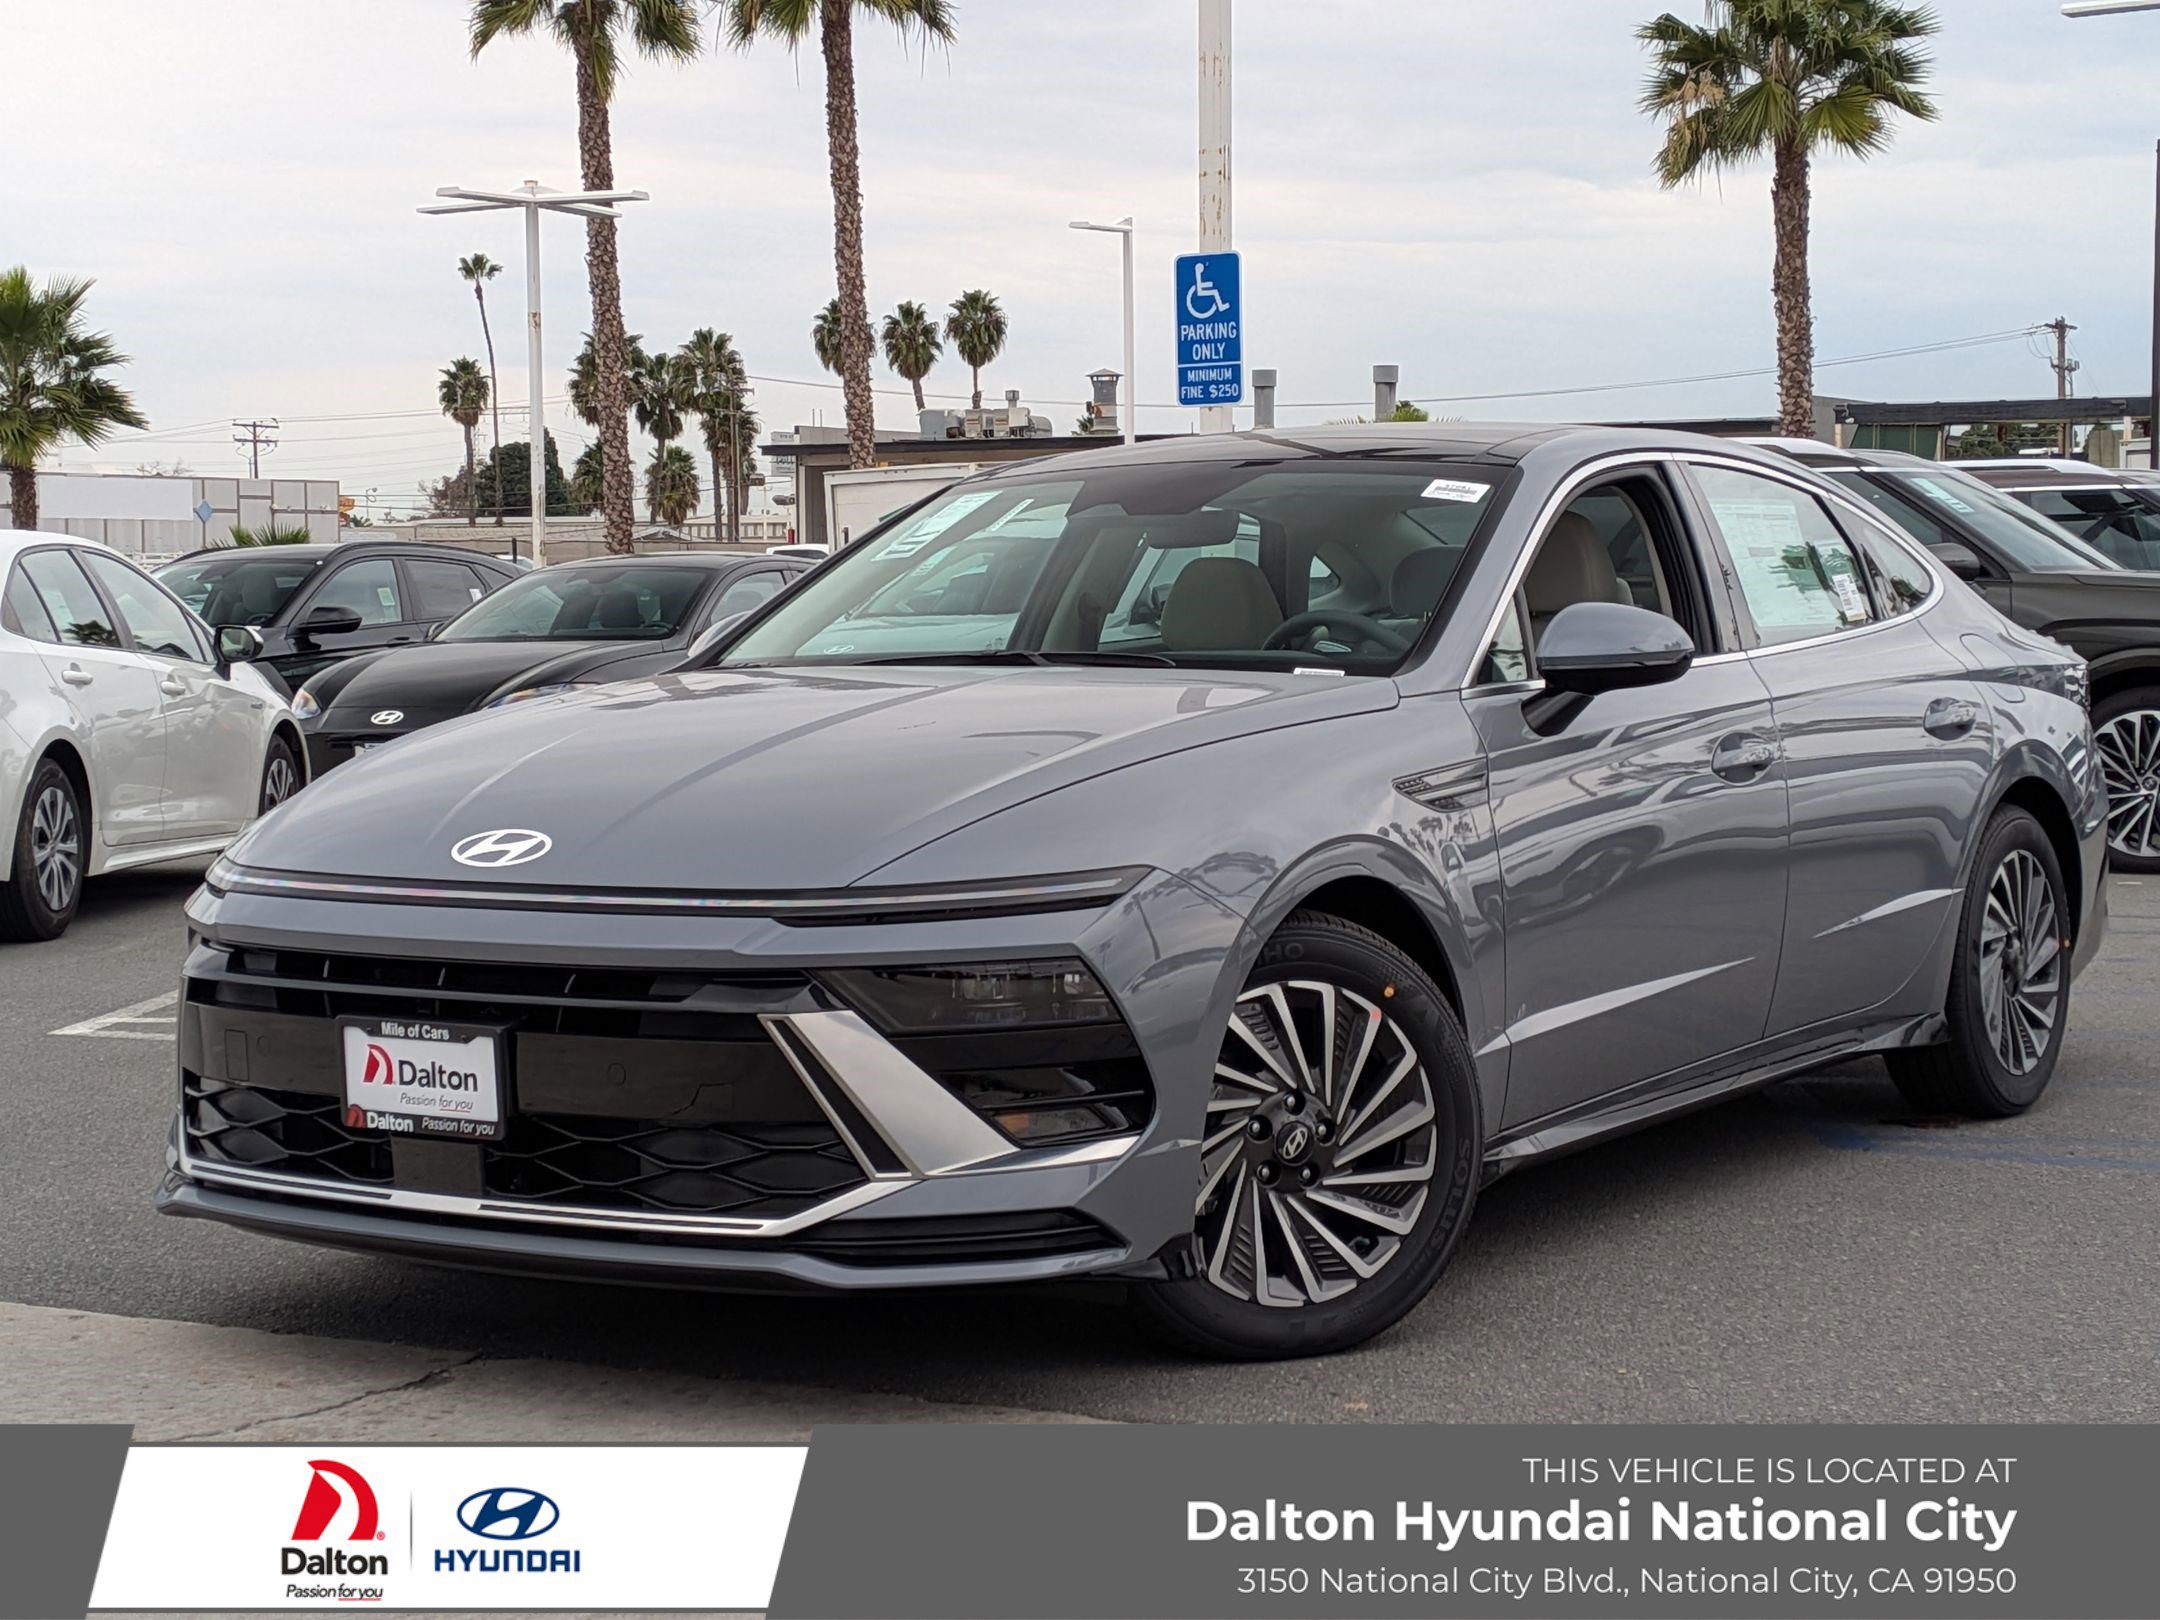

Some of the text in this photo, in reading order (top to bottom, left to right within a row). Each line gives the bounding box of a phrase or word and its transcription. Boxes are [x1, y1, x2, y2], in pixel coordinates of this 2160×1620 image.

[1181, 321, 1237, 341] PARKING
[1192, 342, 1226, 361] ONLY
[1187, 368, 1232, 382] MINIMUM
[1181, 384, 1239, 399] FINE $250
[381, 1021, 449, 1040] Mile of Cars
[398, 1060, 478, 1092] Dalton
[400, 1092, 474, 1111] Passion for you
[366, 1112, 495, 1137] Dalton Passion for you
